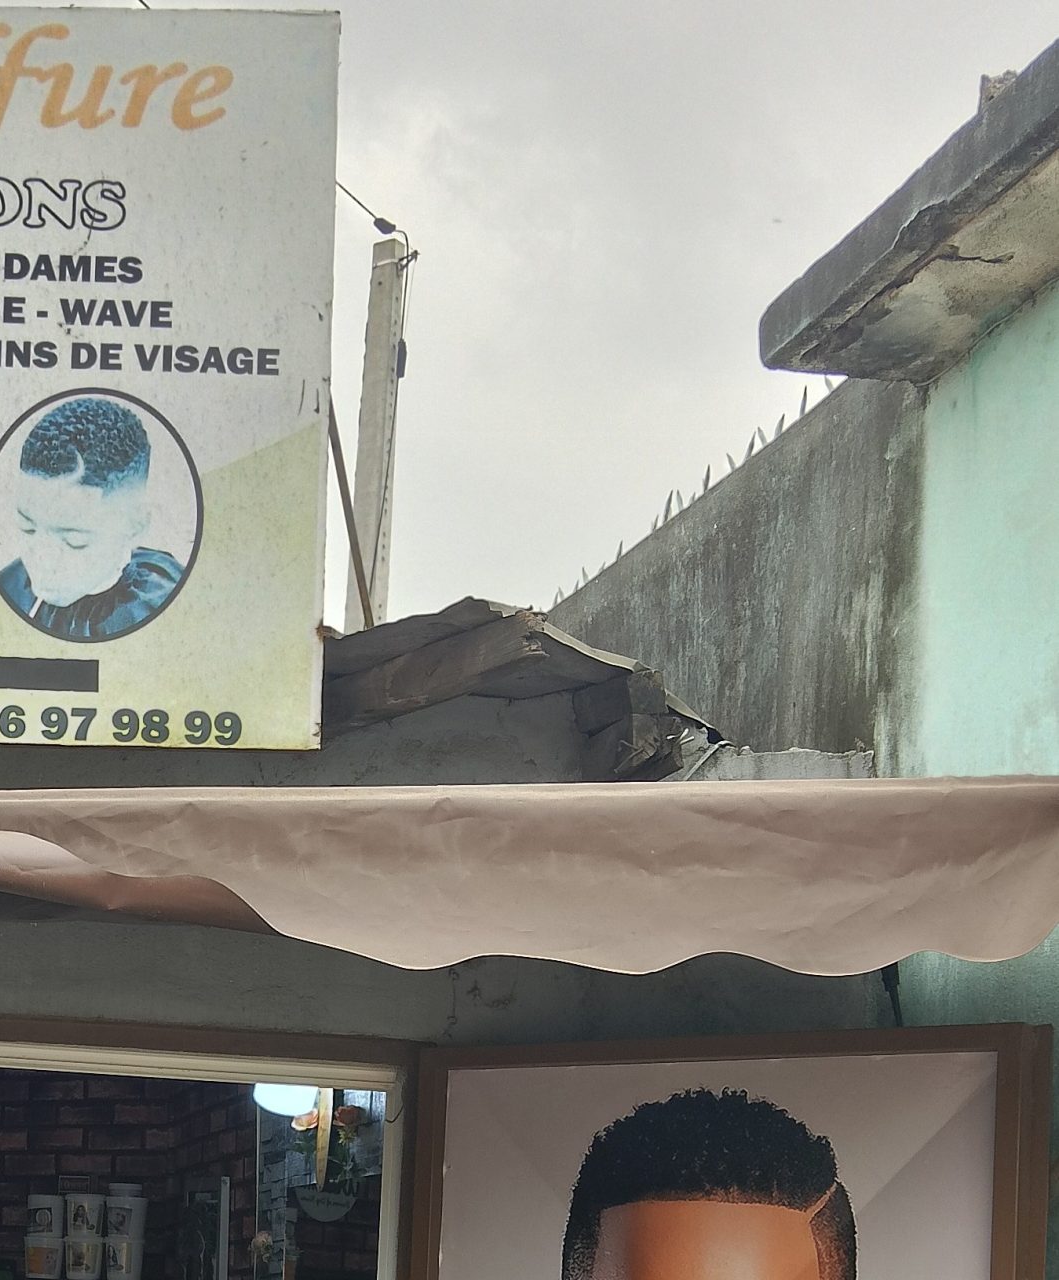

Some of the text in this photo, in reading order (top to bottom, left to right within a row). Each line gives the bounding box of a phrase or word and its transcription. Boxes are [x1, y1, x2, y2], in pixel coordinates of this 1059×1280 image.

[4, 253, 142, 283] DAMES
[60, 299, 172, 328] WAVE
[71, 343, 122, 370] DE
[135, 344, 279, 375] VISAGE
[40, 706, 97, 741] 97
[111, 708, 169, 743] 98
[183, 711, 242, 745] 99
